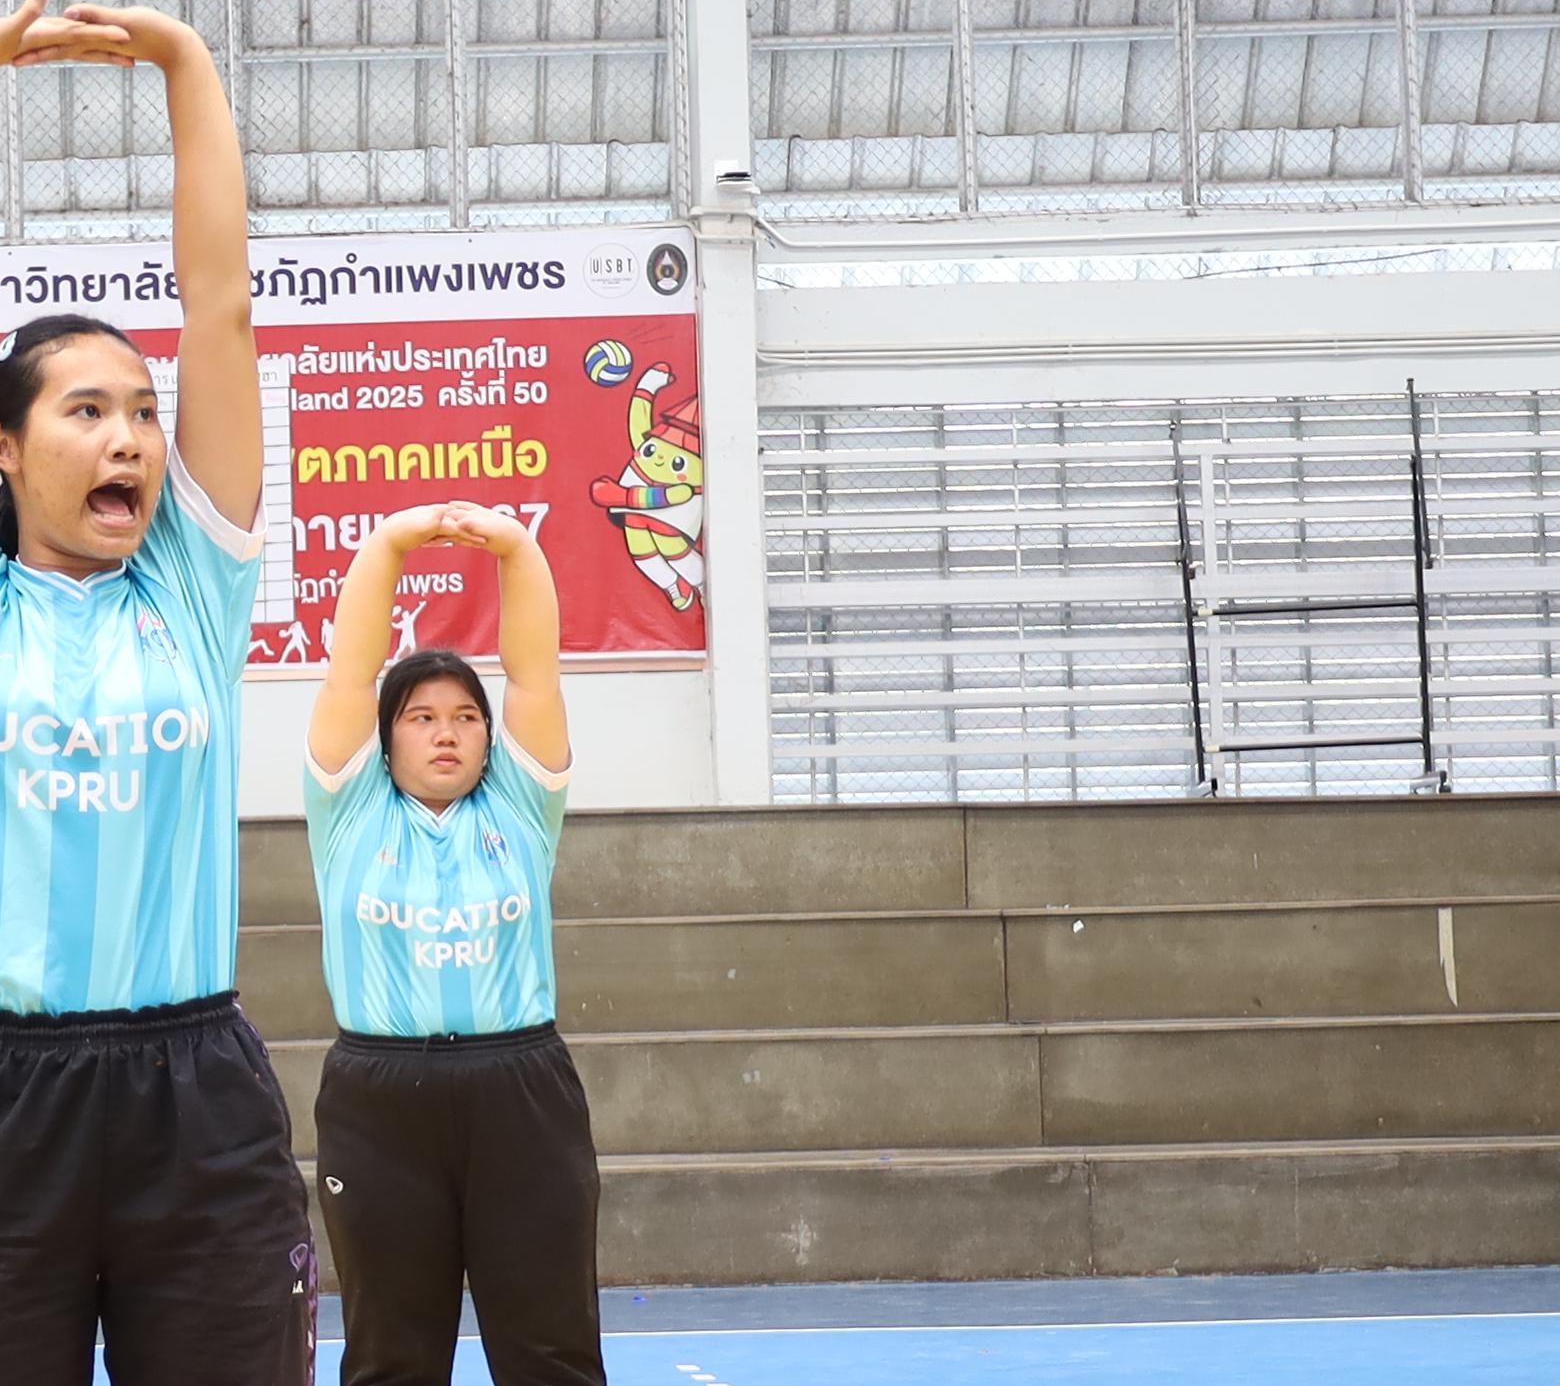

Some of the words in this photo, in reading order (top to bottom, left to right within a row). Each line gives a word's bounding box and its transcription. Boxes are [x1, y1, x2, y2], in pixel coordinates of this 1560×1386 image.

[290, 386, 349, 411] land
[355, 386, 424, 410] 2025
[438, 372, 506, 408] ครั้งที่
[513, 381, 548, 404] 50
[291, 424, 548, 484] ตภาคเหนือ
[16, 768, 141, 813] KPRU
[414, 935, 496, 969] KPRU
